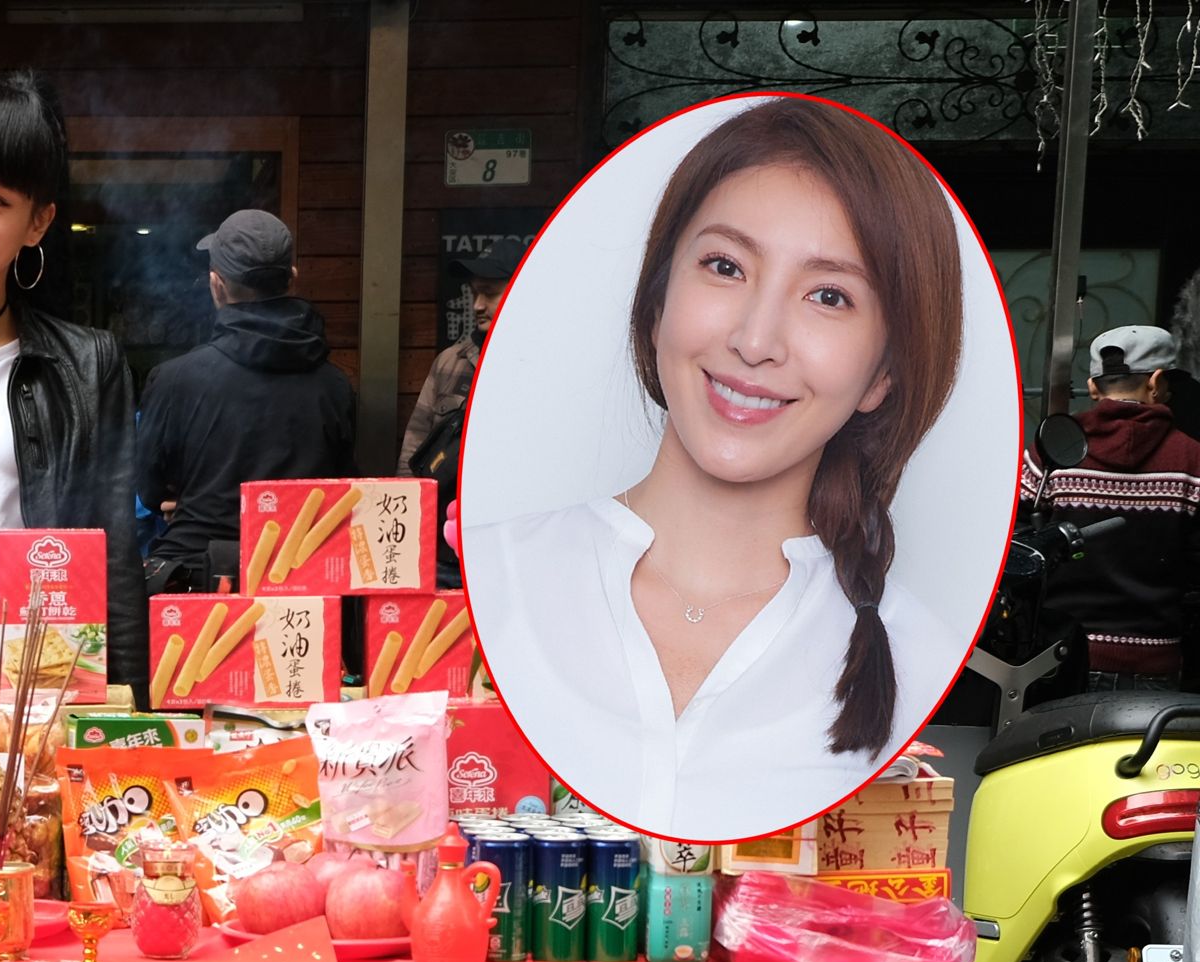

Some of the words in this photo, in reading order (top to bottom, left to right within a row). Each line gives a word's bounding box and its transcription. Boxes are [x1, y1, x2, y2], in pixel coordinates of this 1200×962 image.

[482, 159, 498, 182] 8
[375, 493, 409, 585] 奶油蛋捲
[279, 608, 312, 699] 奶油蛋捲
[450, 787, 495, 803] 喜年來
